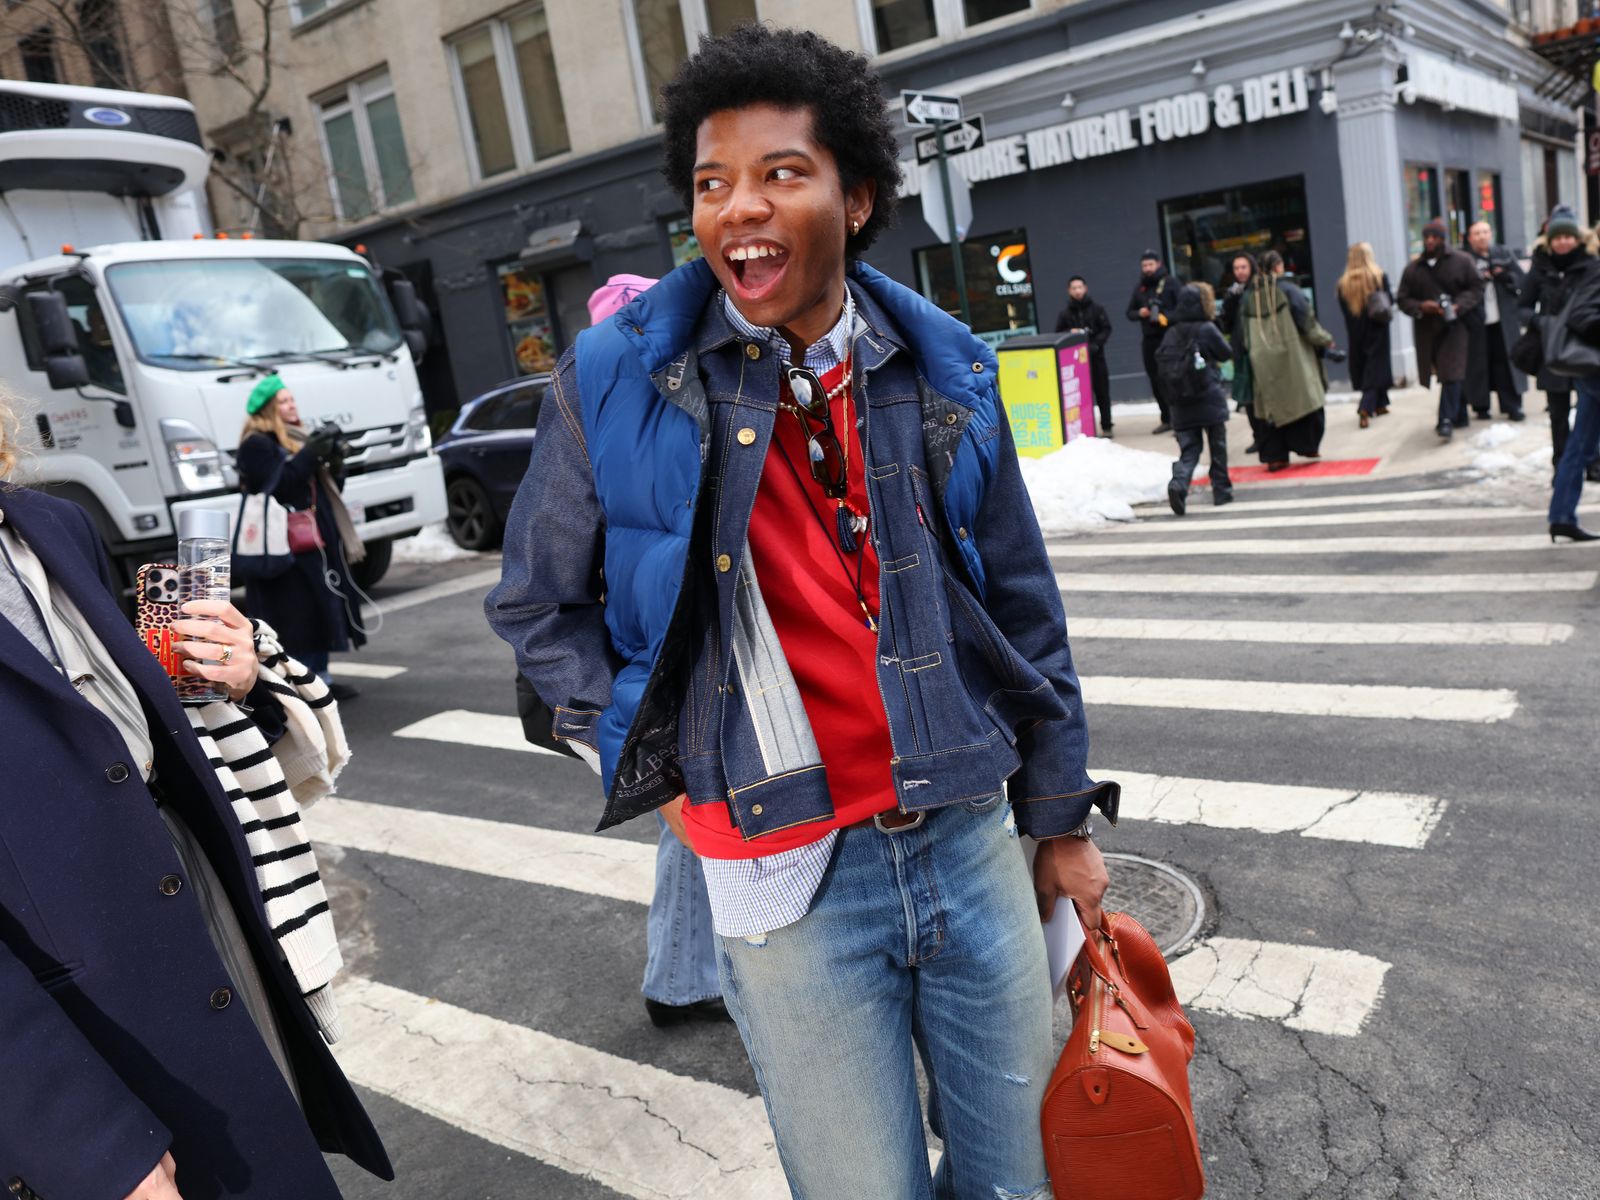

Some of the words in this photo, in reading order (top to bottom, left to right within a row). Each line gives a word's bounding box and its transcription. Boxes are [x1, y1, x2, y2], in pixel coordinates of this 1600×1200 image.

[1026, 109, 1138, 171] NATURAL
[1139, 91, 1210, 146] FOOD
[1214, 83, 1242, 129] &
[1243, 66, 1309, 123] DELI
[996, 283, 1033, 296] CELSIUS
[620, 744, 679, 788] L.L.Bea
